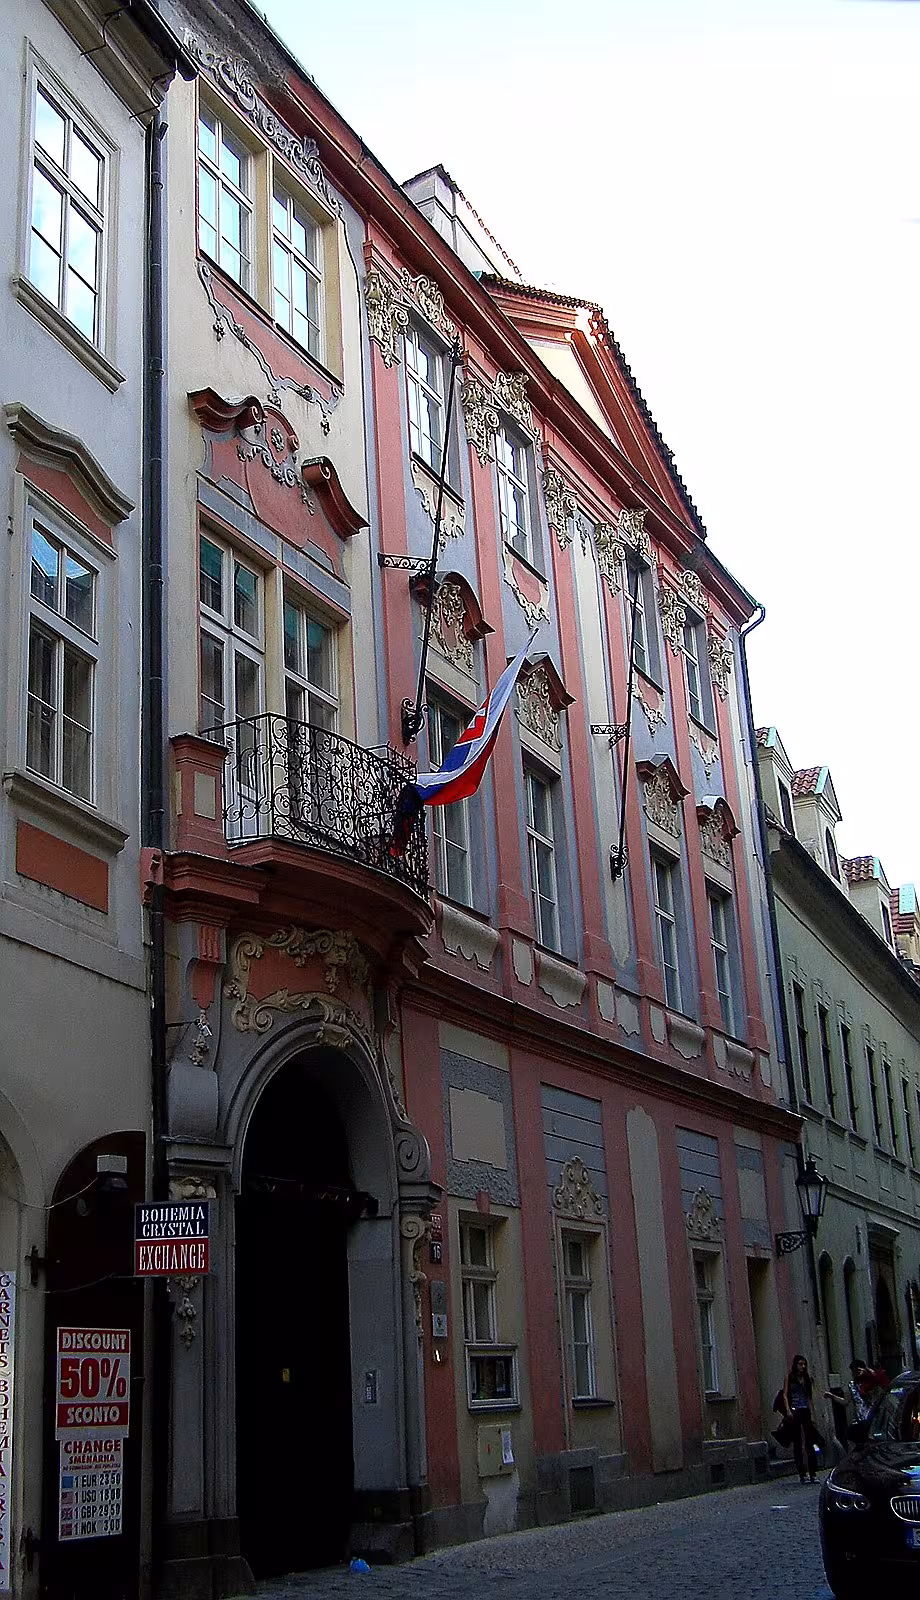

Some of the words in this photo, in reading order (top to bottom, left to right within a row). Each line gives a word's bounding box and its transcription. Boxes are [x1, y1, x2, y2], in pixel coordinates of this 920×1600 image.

[140, 1206, 205, 1222] BOHEMIA
[142, 1221, 204, 1237] CRYSTAL
[138, 1244, 205, 1271] EXCHANGE
[62, 1332, 127, 1350] DISCOUNT
[60, 1358, 127, 1398] 50%
[66, 1406, 120, 1424] SCONTO
[63, 1440, 121, 1454] CHANGE
[74, 1475, 79, 1488] 1
[82, 1474, 97, 1488] EUR
[74, 1491, 79, 1503] 1
[81, 1490, 97, 1503] USD
[74, 1507, 79, 1519] 1
[80, 1505, 98, 1519] GBP
[74, 1523, 78, 1535] 1
[80, 1521, 97, 1535] NOK
